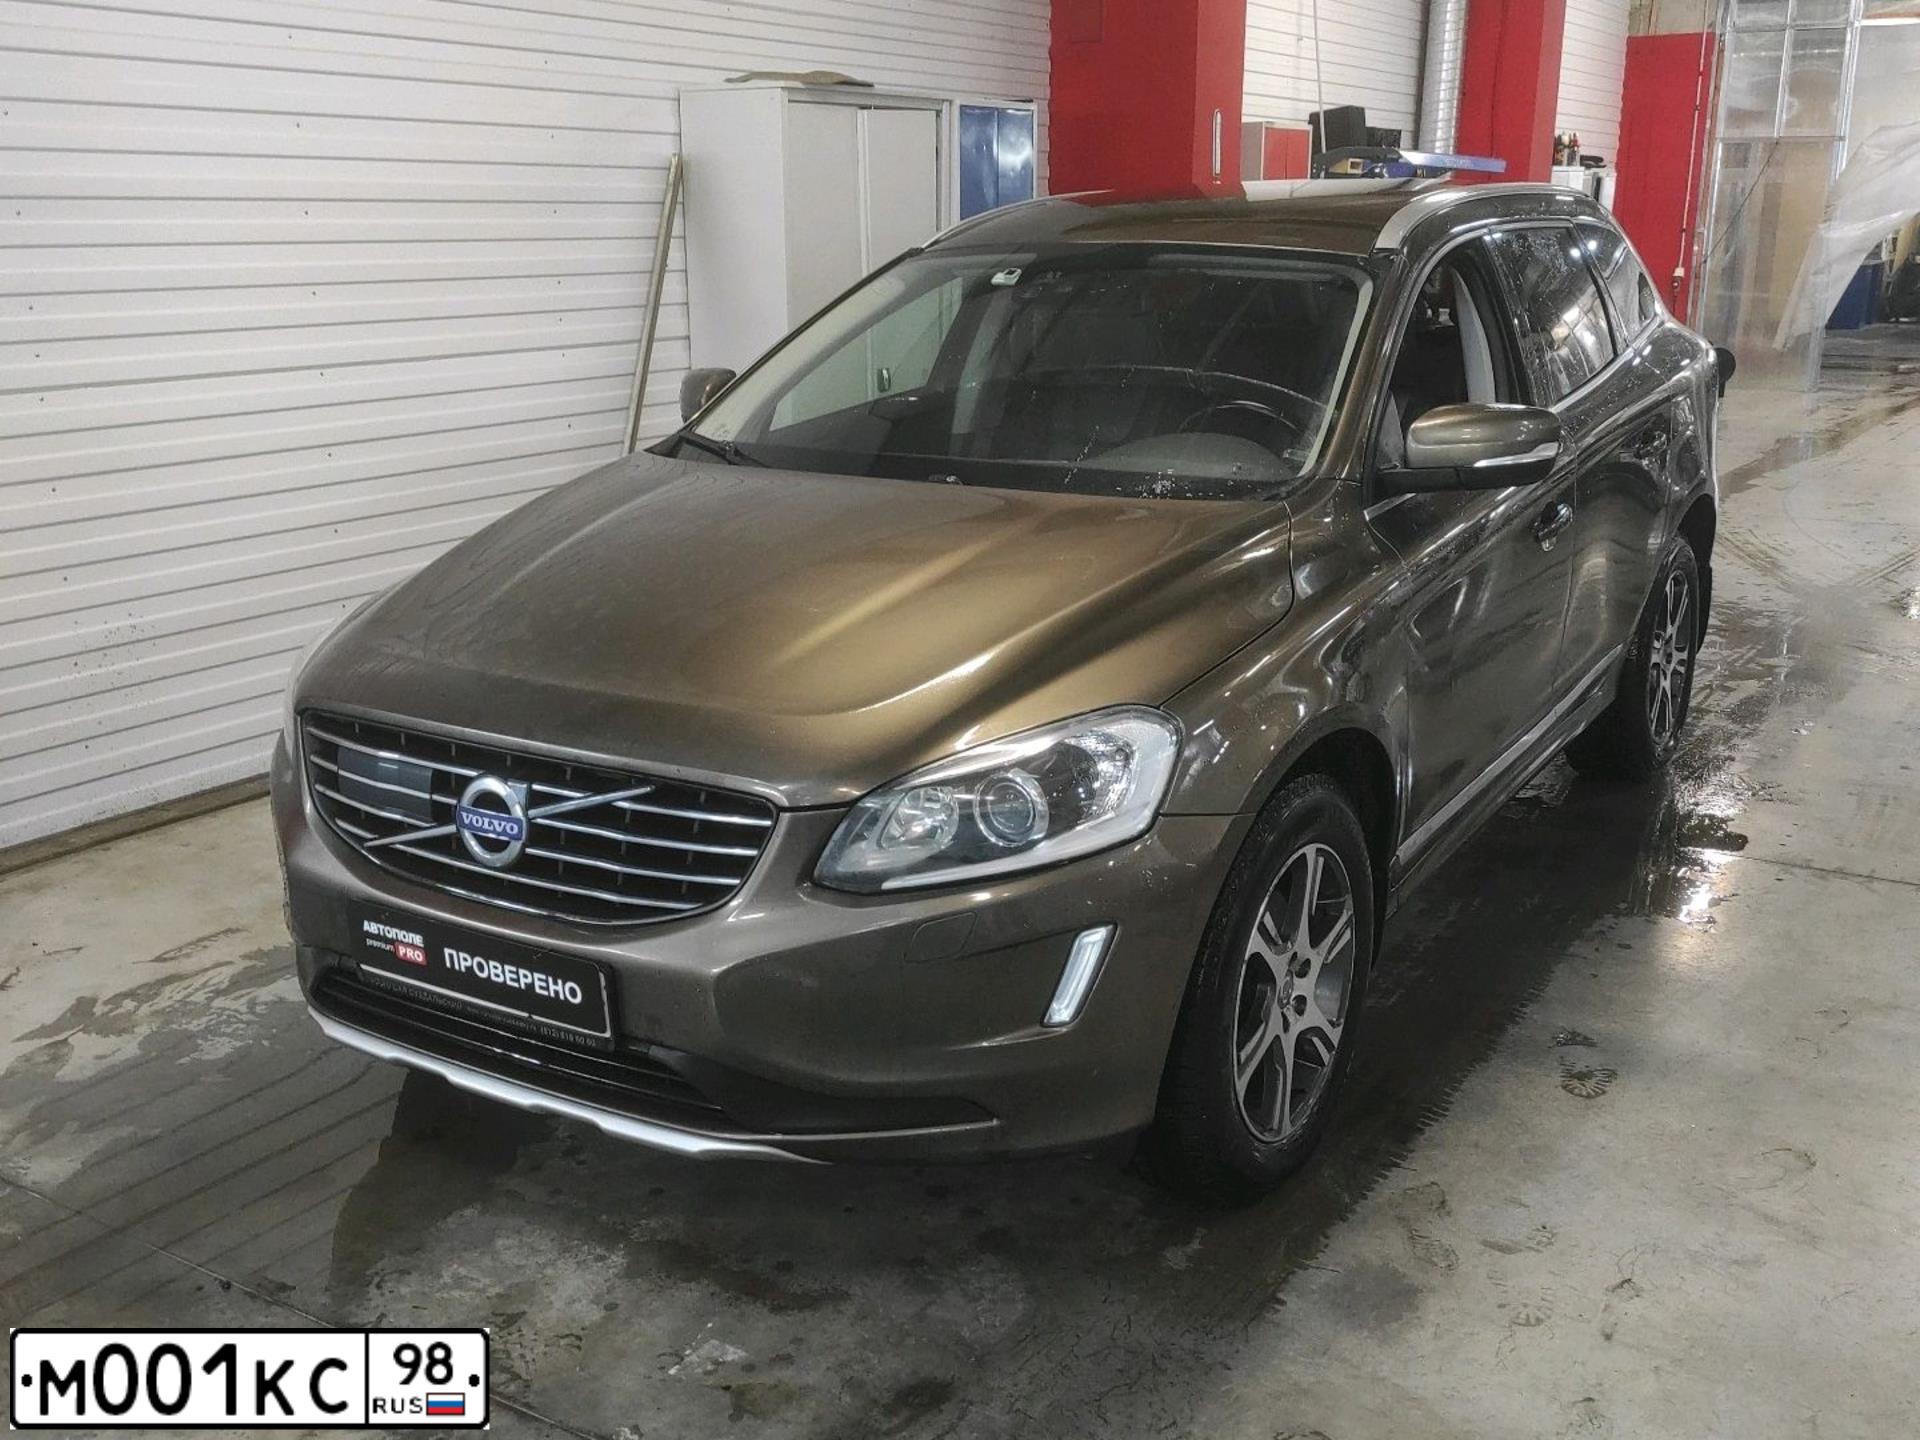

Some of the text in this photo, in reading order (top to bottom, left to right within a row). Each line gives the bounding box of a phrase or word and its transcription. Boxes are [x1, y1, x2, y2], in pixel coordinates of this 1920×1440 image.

[460, 812, 519, 835] VOLVO
[363, 920, 424, 948] АВТОПОЛЕ
[398, 945, 424, 962] PRO
[443, 947, 583, 1004] ПРОВЕРЕНО
